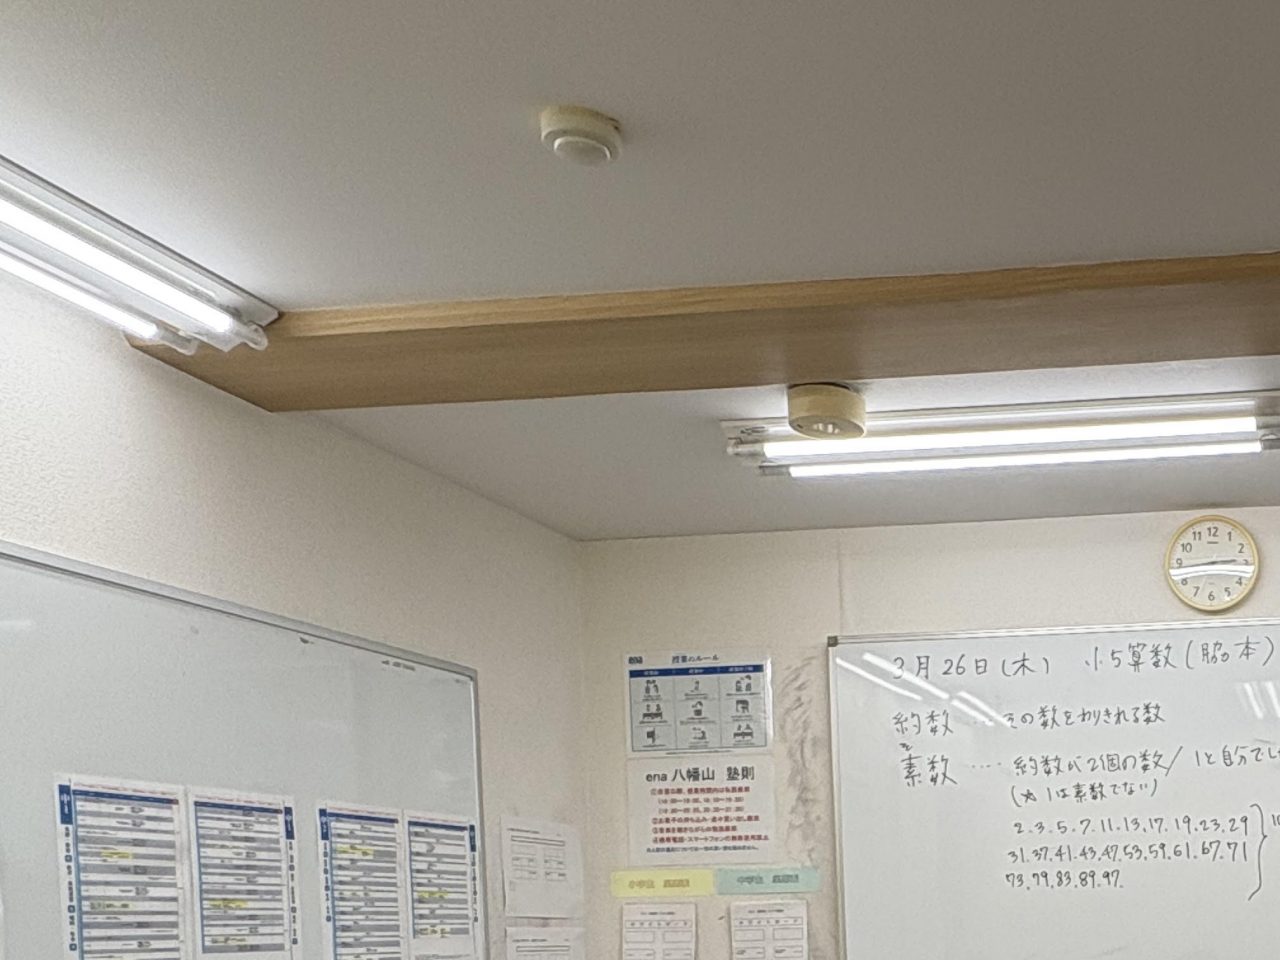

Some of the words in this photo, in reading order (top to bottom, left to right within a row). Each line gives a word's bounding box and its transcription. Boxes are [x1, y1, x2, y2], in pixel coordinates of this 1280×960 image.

[1193, 531, 1202, 541] 11
[1207, 527, 1219, 537] 12
[1227, 531, 1232, 542] 1
[1181, 542, 1193, 553] 10
[1238, 543, 1245, 554] 2
[1176, 558, 1183, 567] 9
[1193, 586, 1200, 597] 7
[1208, 591, 1215, 602] 6
[1224, 587, 1231, 597] 5
[892, 709, 953, 736] 約数
[645, 773, 668, 782] ena
[671, 767, 715, 782] 八幡山
